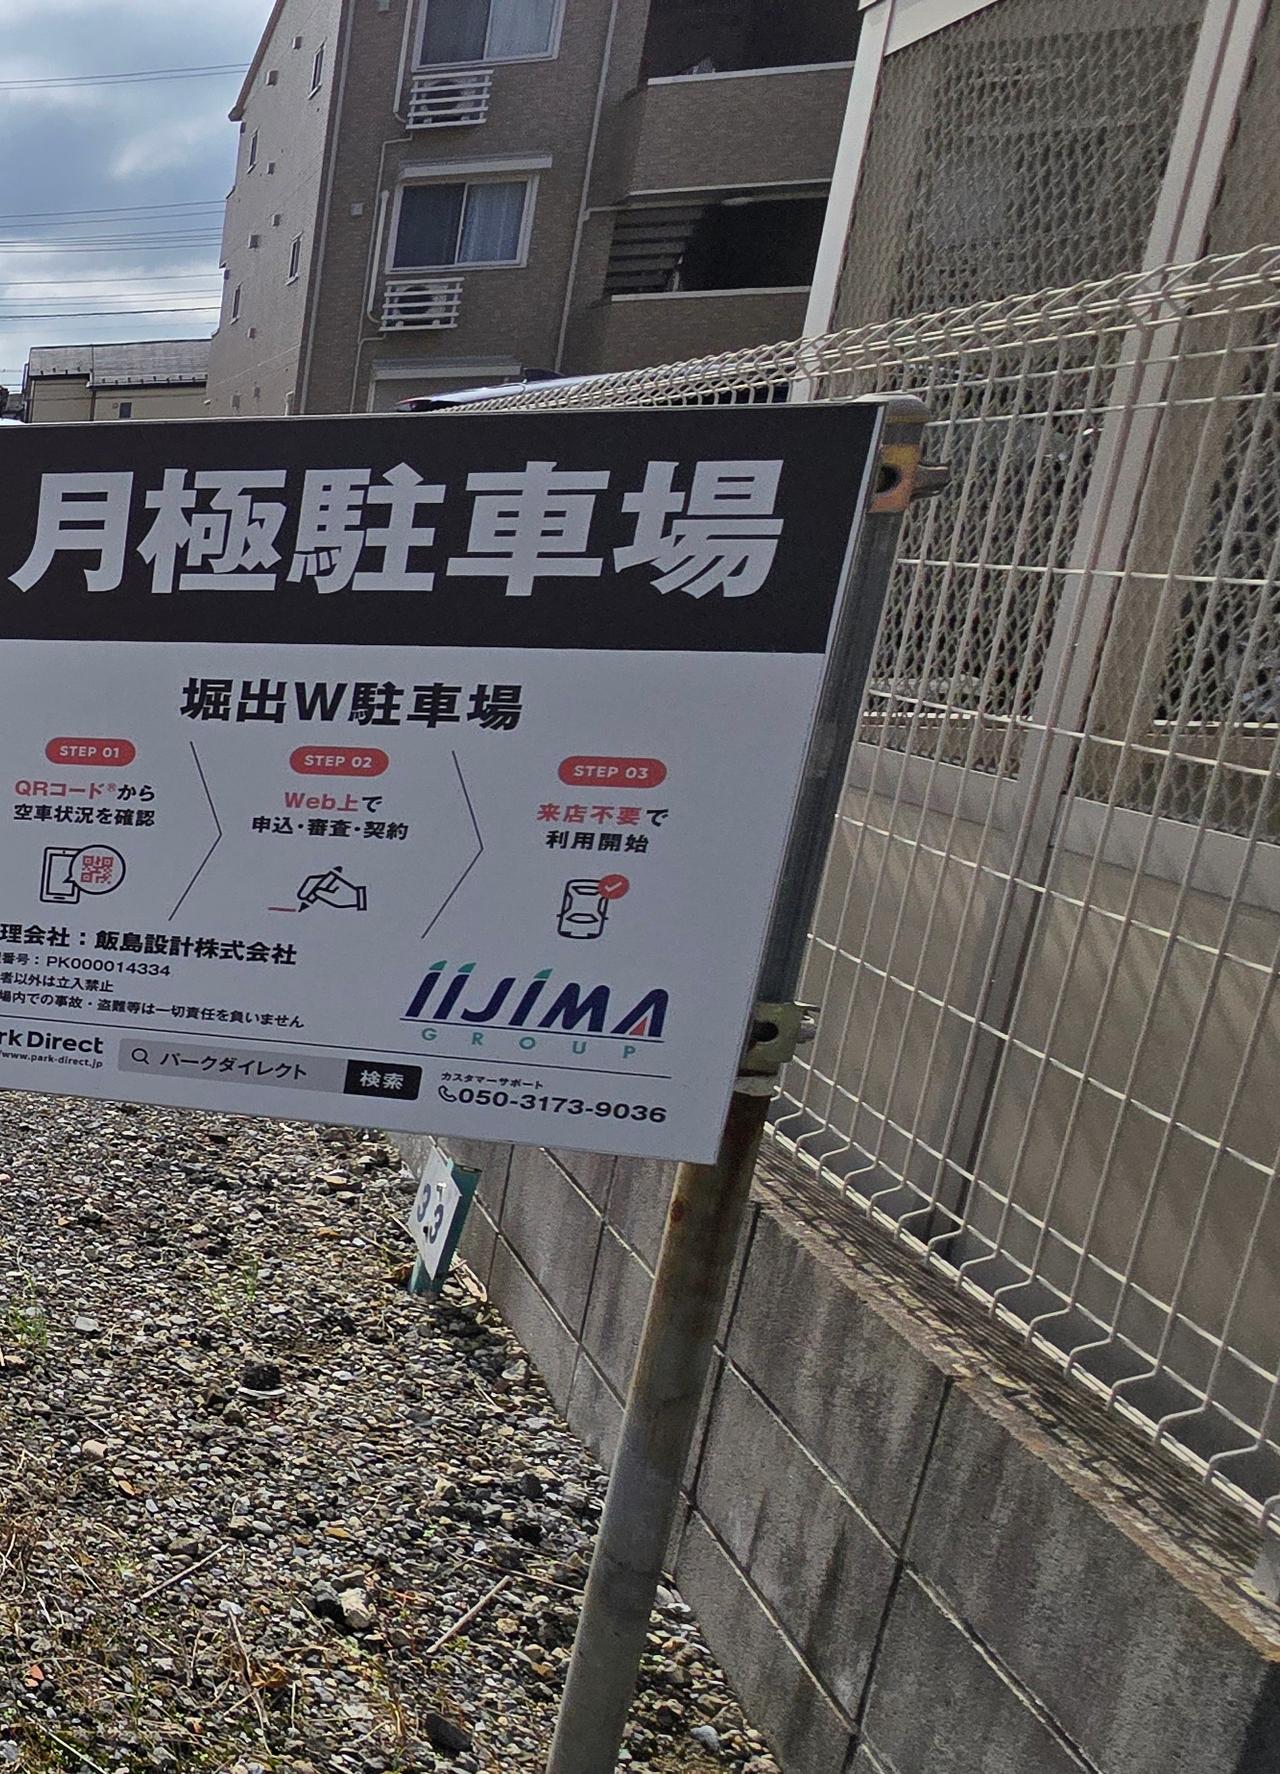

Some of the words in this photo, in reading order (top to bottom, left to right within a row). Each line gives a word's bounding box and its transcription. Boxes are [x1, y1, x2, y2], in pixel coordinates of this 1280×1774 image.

[8, 459, 785, 599] 月極駐車場
[179, 676, 524, 732] 堀出W駐車場
[59, 745, 97, 758] STEP
[102, 747, 121, 759] 01
[303, 754, 346, 767] STEP
[351, 756, 373, 769] 02
[573, 765, 619, 778] STEP
[625, 767, 649, 780] 03
[284, 791, 383, 814] Web上で
[536, 802, 669, 827] 来店不要で
[13, 803, 156, 827] 空車状況を確認
[251, 815, 409, 841] 申込・審査・契約
[545, 830, 649, 854] 利用開始
[26, 1030, 104, 1055] Direct
[159, 1051, 308, 1081] パークダイレクト
[359, 1069, 405, 1090] 検索
[440, 1071, 544, 1090] カスタマーサポート
[457, 1087, 668, 1124] 050-3173-9036
